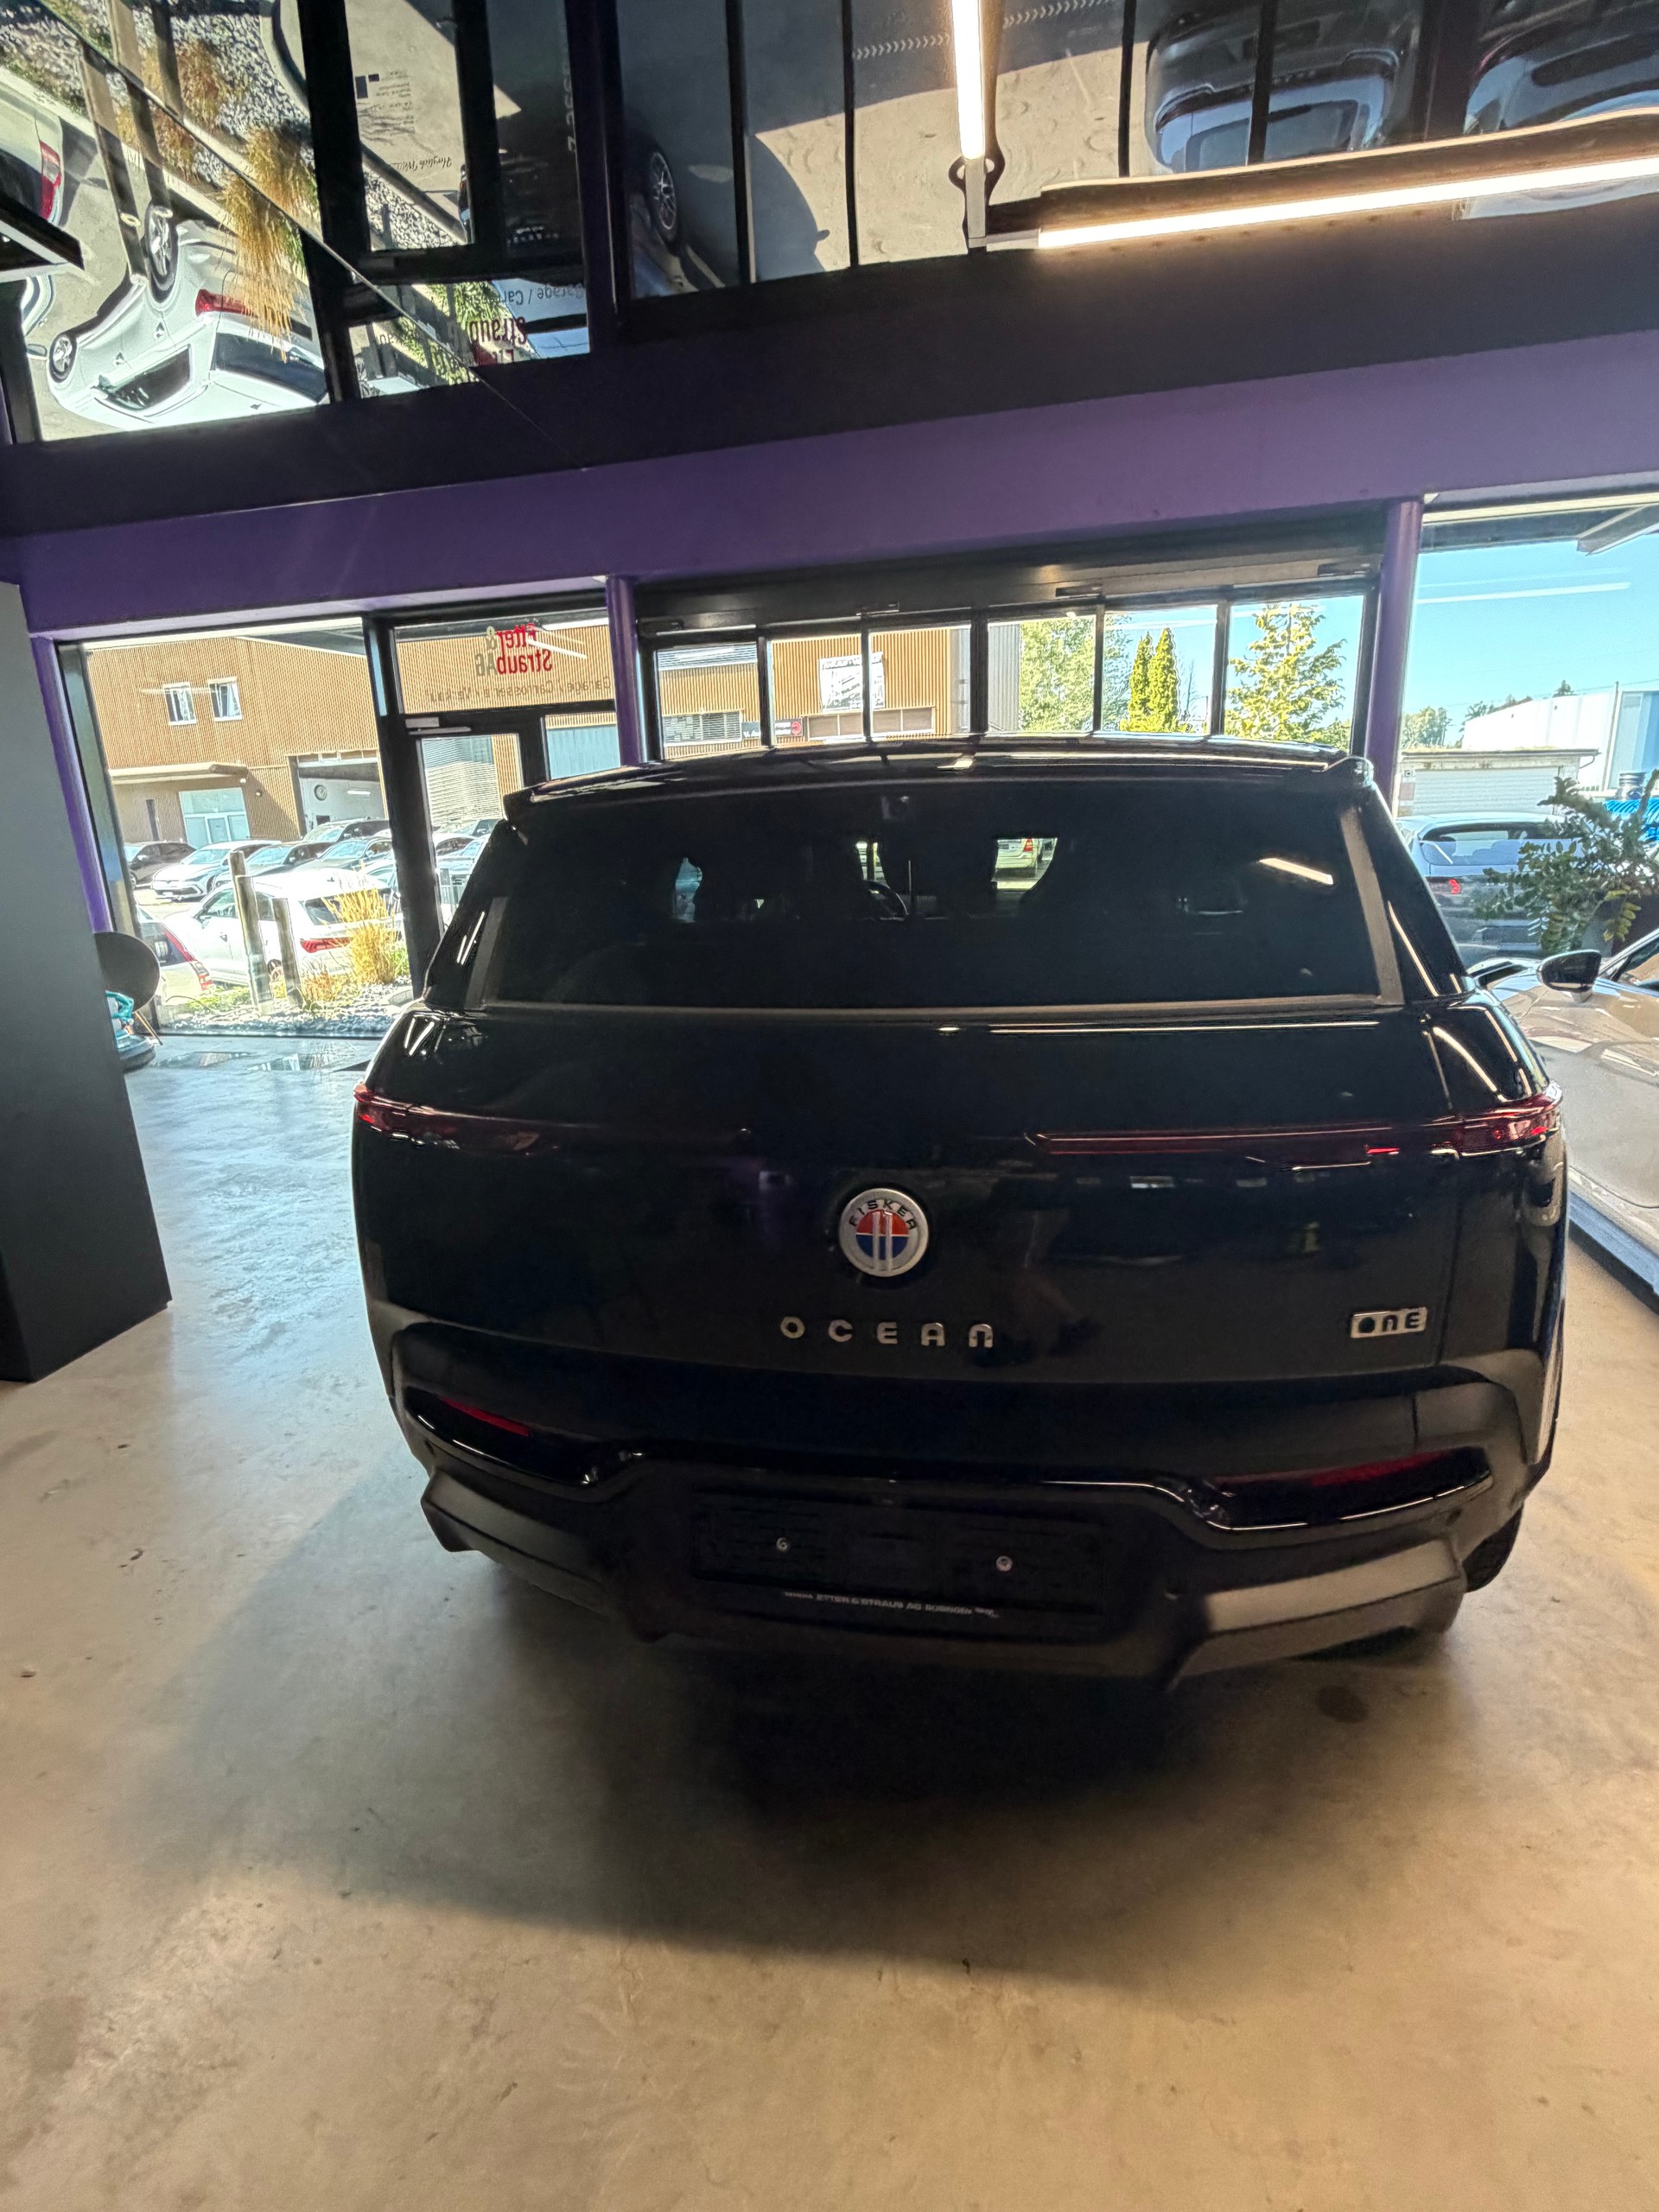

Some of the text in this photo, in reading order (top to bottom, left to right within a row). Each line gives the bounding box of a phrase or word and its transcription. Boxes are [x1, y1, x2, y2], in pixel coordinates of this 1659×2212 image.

[468, 316, 528, 347] Straub
[849, 1198, 918, 1231] FISKER
[780, 1315, 994, 1349] OCEAN
